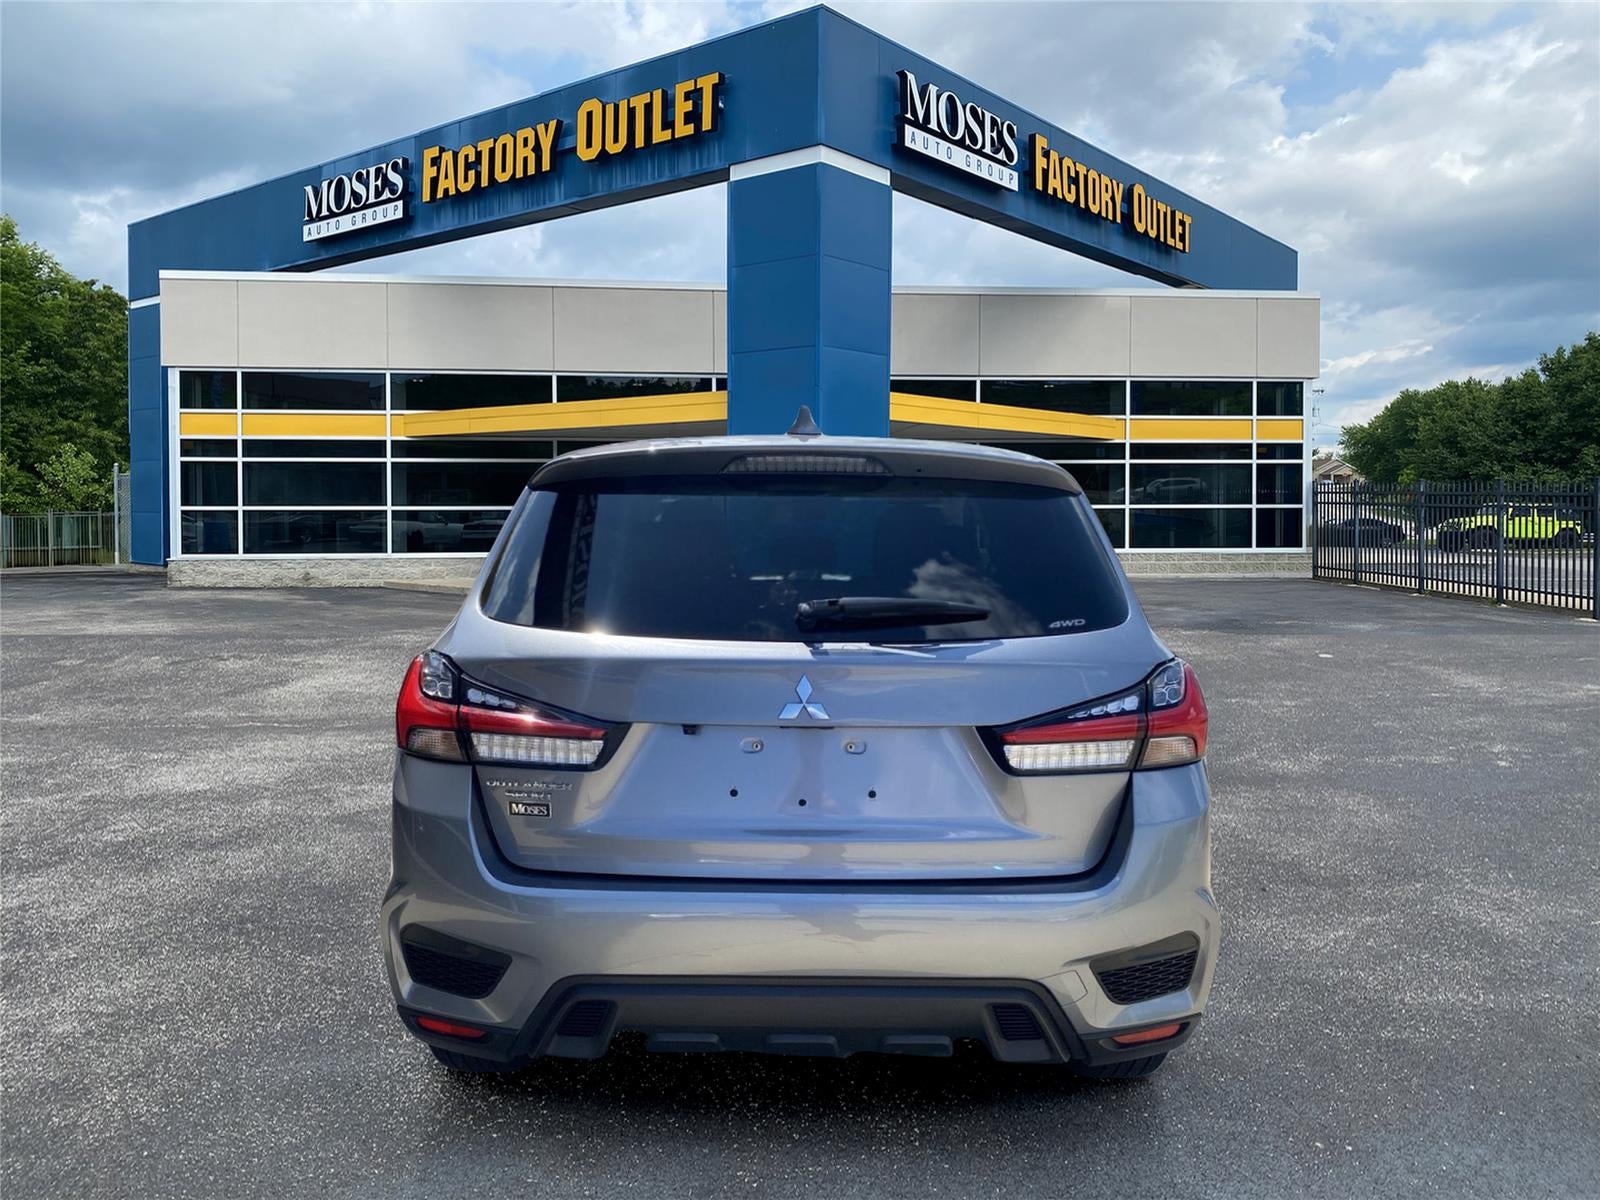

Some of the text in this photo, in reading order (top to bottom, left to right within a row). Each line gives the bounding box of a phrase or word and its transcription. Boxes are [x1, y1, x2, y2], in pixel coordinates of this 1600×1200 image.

[422, 72, 720, 203] FACTORY OUTLET
[904, 70, 1018, 166] MOSES
[910, 131, 1015, 185] AUTO GROUP
[303, 157, 404, 221] MOSES
[1034, 132, 1192, 253] FACTORY OUTLET
[306, 204, 400, 238] AUTO GROUP
[1049, 618, 1086, 628] 4WD
[511, 803, 547, 816] MOSES
